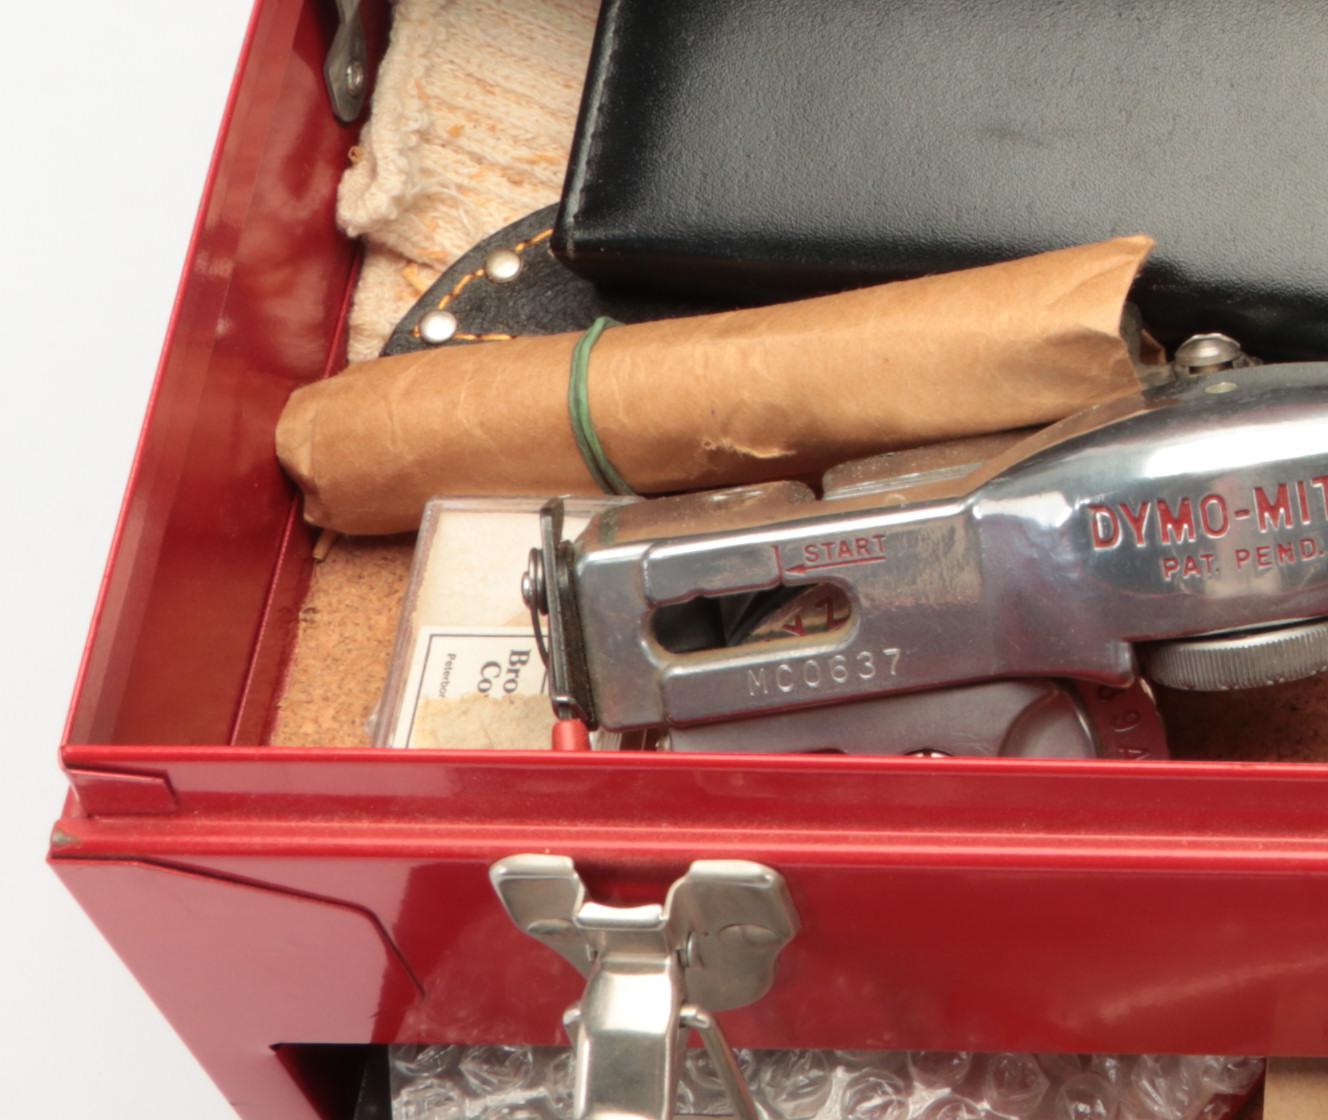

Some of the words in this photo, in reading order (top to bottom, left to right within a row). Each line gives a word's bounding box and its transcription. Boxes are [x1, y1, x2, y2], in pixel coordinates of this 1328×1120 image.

[803, 533, 888, 564] START
[1161, 552, 1222, 580] PAT.
[1235, 537, 1327, 568] PEND.
